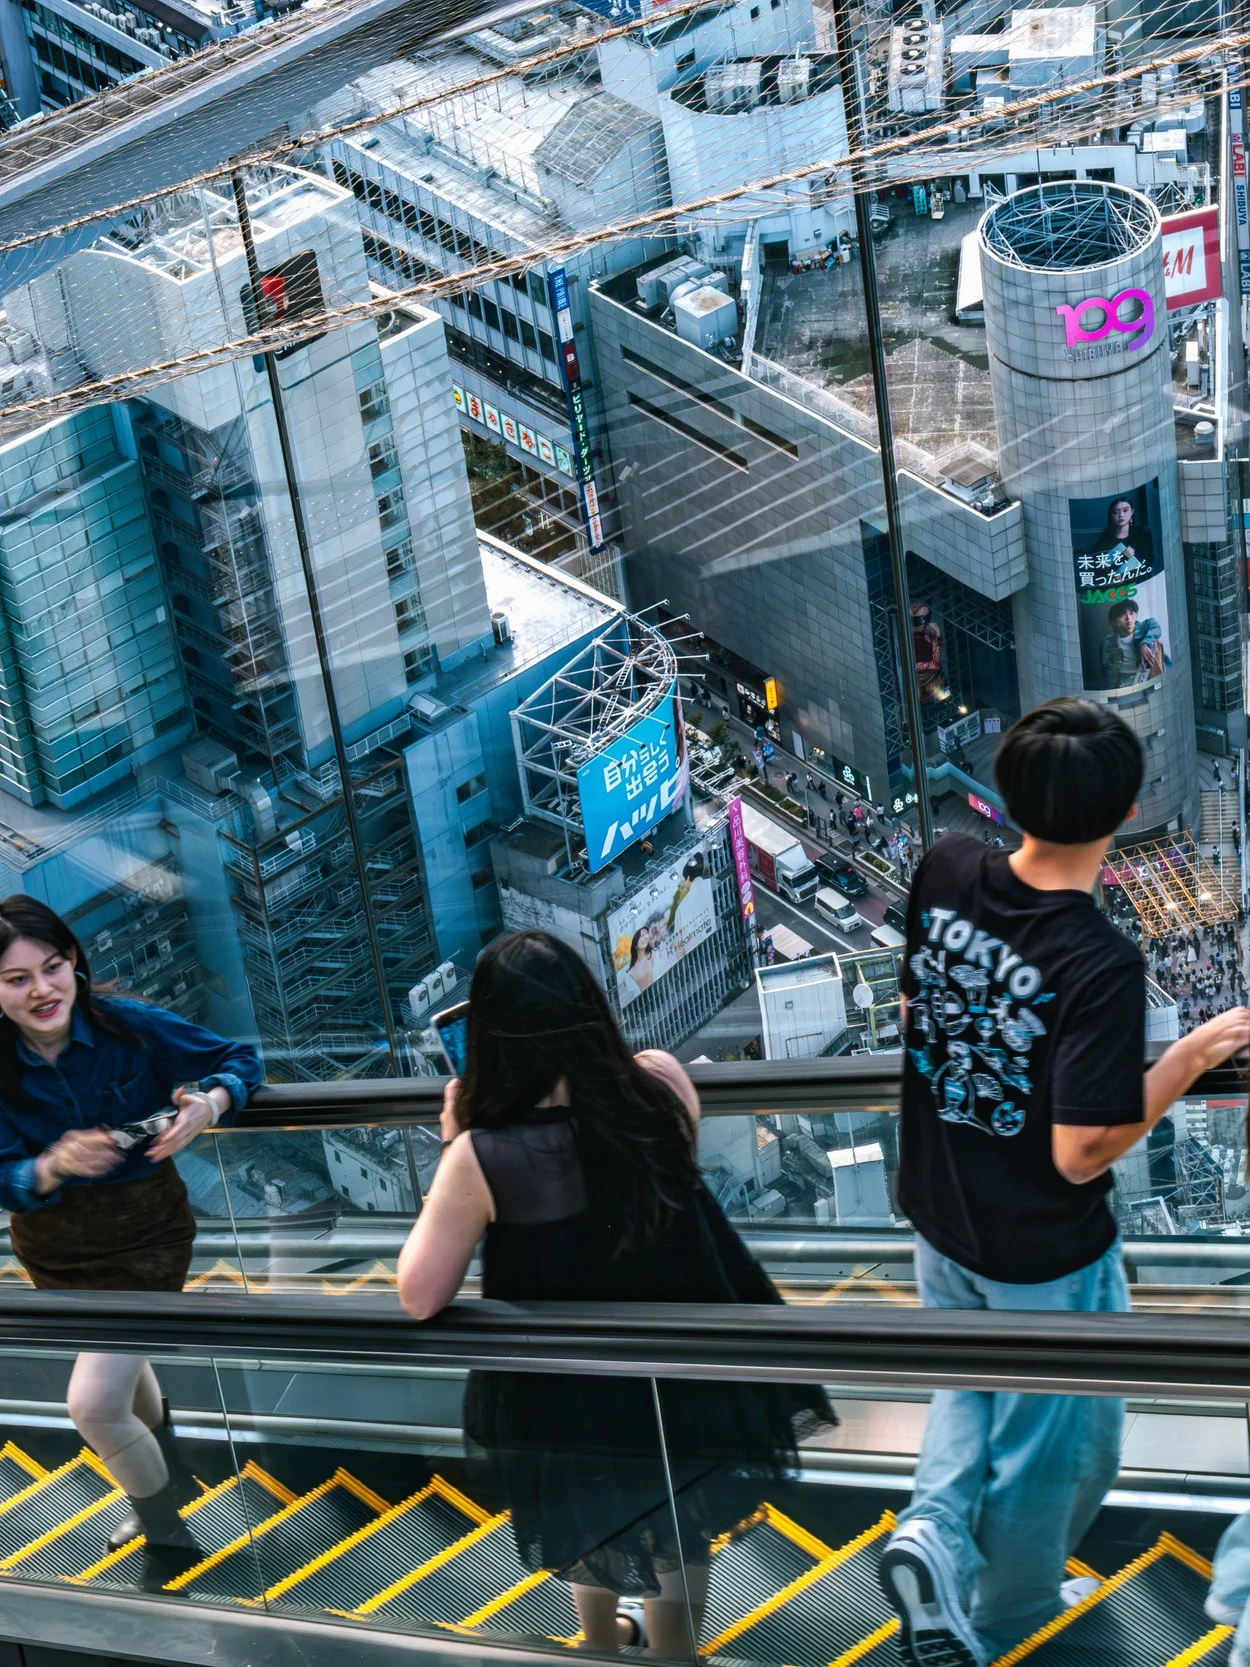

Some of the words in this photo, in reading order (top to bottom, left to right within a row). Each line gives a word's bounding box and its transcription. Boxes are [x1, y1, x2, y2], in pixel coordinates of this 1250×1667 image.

[1232, 144, 1245, 176] LABI
[1236, 184, 1247, 225] SHIBUYA
[1056, 288, 1155, 352] 109
[1066, 341, 1123, 362] SHIBUYA
[468, 397, 552, 462] まねきねこ
[1077, 550, 1129, 570] 未来を、
[1079, 559, 1152, 587] 買ったんだ。
[1080, 582, 1138, 605] JACCS
[603, 729, 668, 793] 自分らしく
[926, 906, 1044, 999] TOKYO
